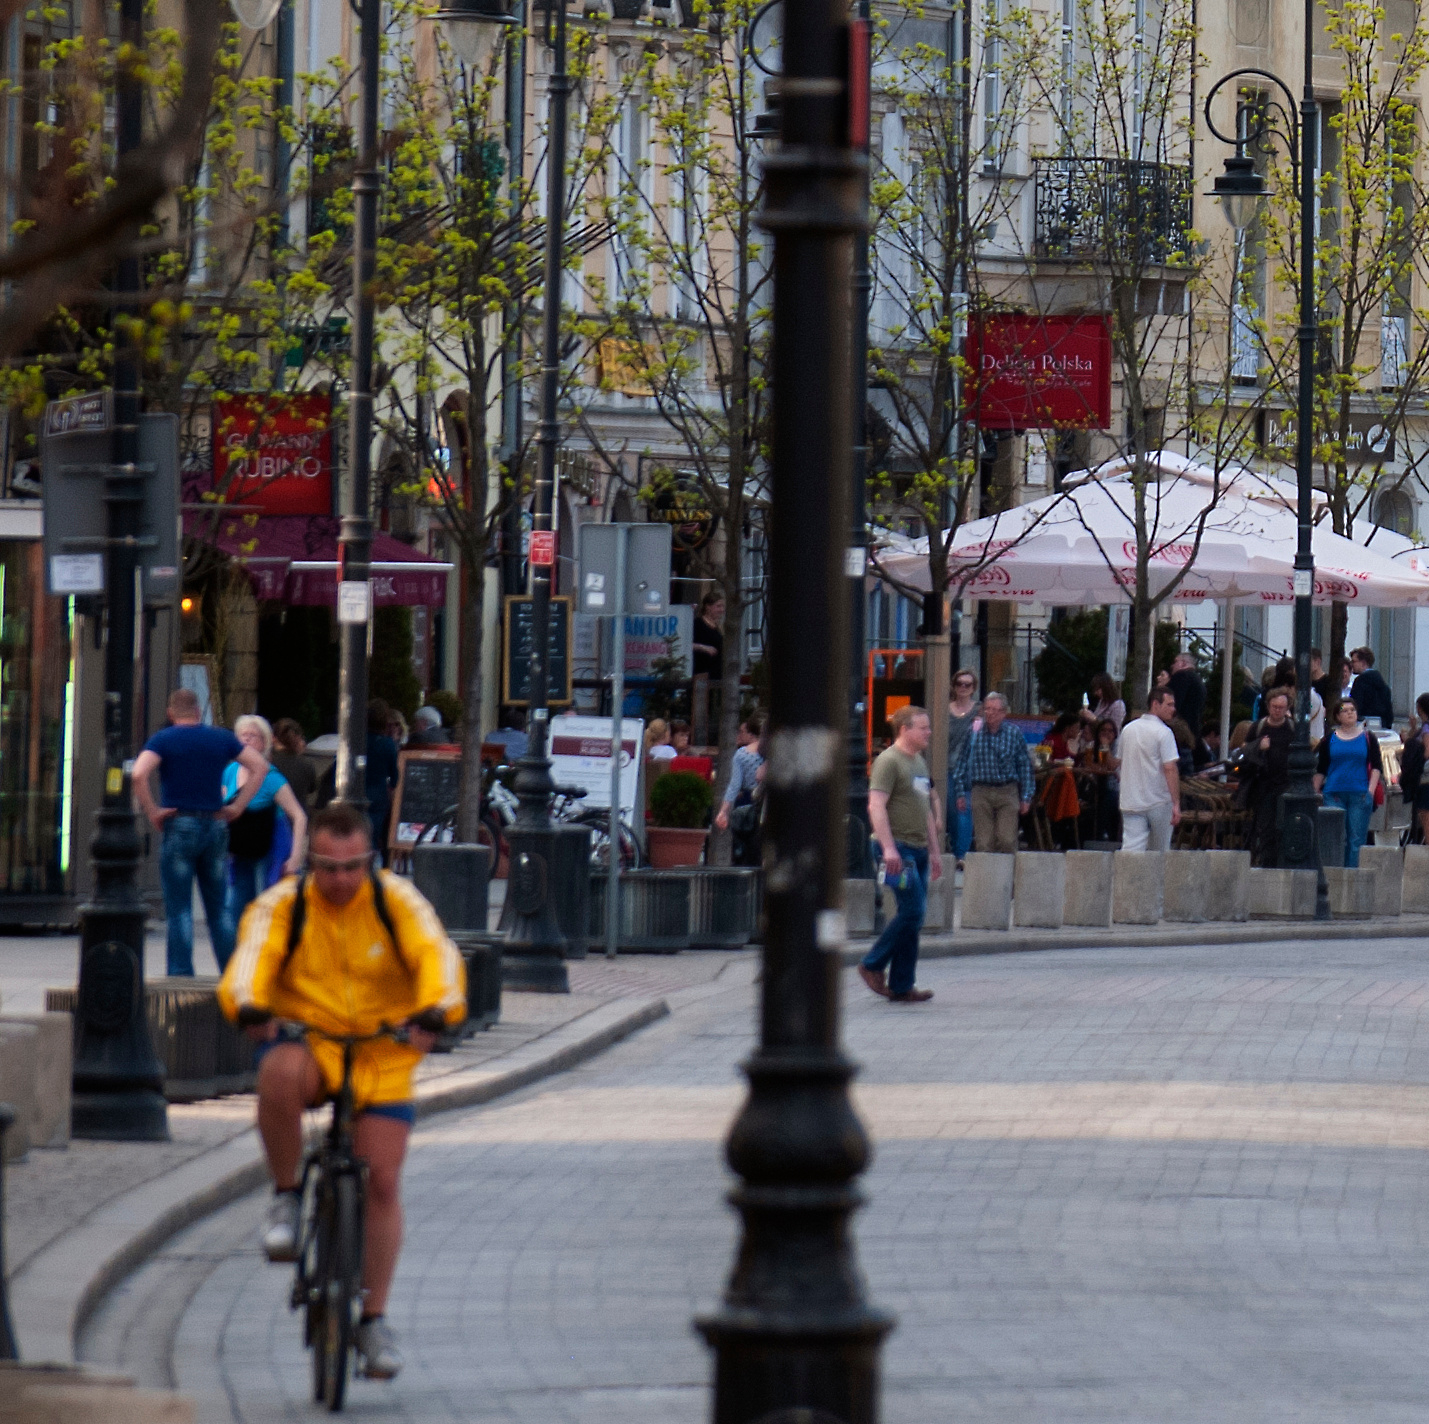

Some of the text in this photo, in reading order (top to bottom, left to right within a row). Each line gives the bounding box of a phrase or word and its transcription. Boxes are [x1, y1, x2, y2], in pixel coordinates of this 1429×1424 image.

[982, 354, 1093, 372] Delicja Polska
[227, 433, 321, 449] GIVANNI
